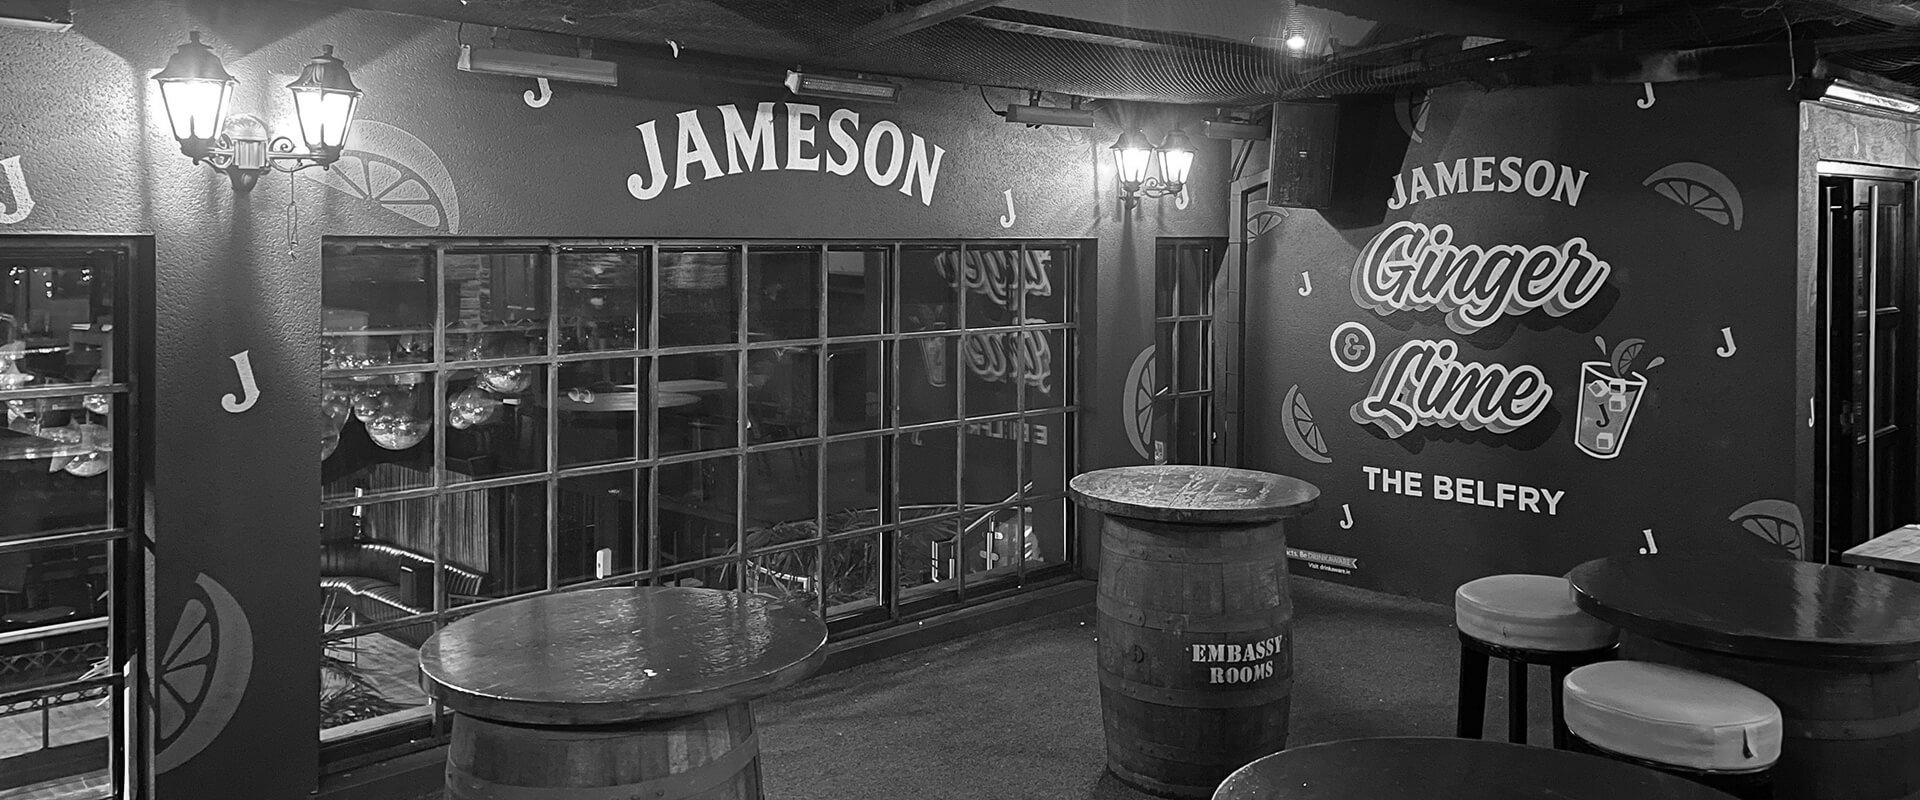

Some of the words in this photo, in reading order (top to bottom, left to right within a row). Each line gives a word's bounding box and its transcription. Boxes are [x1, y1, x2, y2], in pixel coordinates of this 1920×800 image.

[523, 77, 553, 108] J
[1636, 82, 1656, 109] J
[627, 102, 946, 207] JAMESON
[0, 155, 35, 224] J
[1387, 156, 1589, 209] JAMESON
[1000, 188, 1016, 228] J
[1298, 271, 1312, 297] J
[1361, 221, 1611, 328] Ginger
[1716, 326, 1737, 358] J
[221, 349, 260, 413] J
[1343, 332, 1366, 360] &
[1361, 339, 1553, 432] Lime
[1596, 402, 1610, 428] J
[1362, 466, 1422, 497] THE
[1433, 474, 1565, 515] BELFRY
[1339, 503, 1353, 529] J
[1638, 528, 1658, 555] J
[1192, 634, 1282, 662] EMBASSY
[1210, 660, 1273, 684] ROOMS
